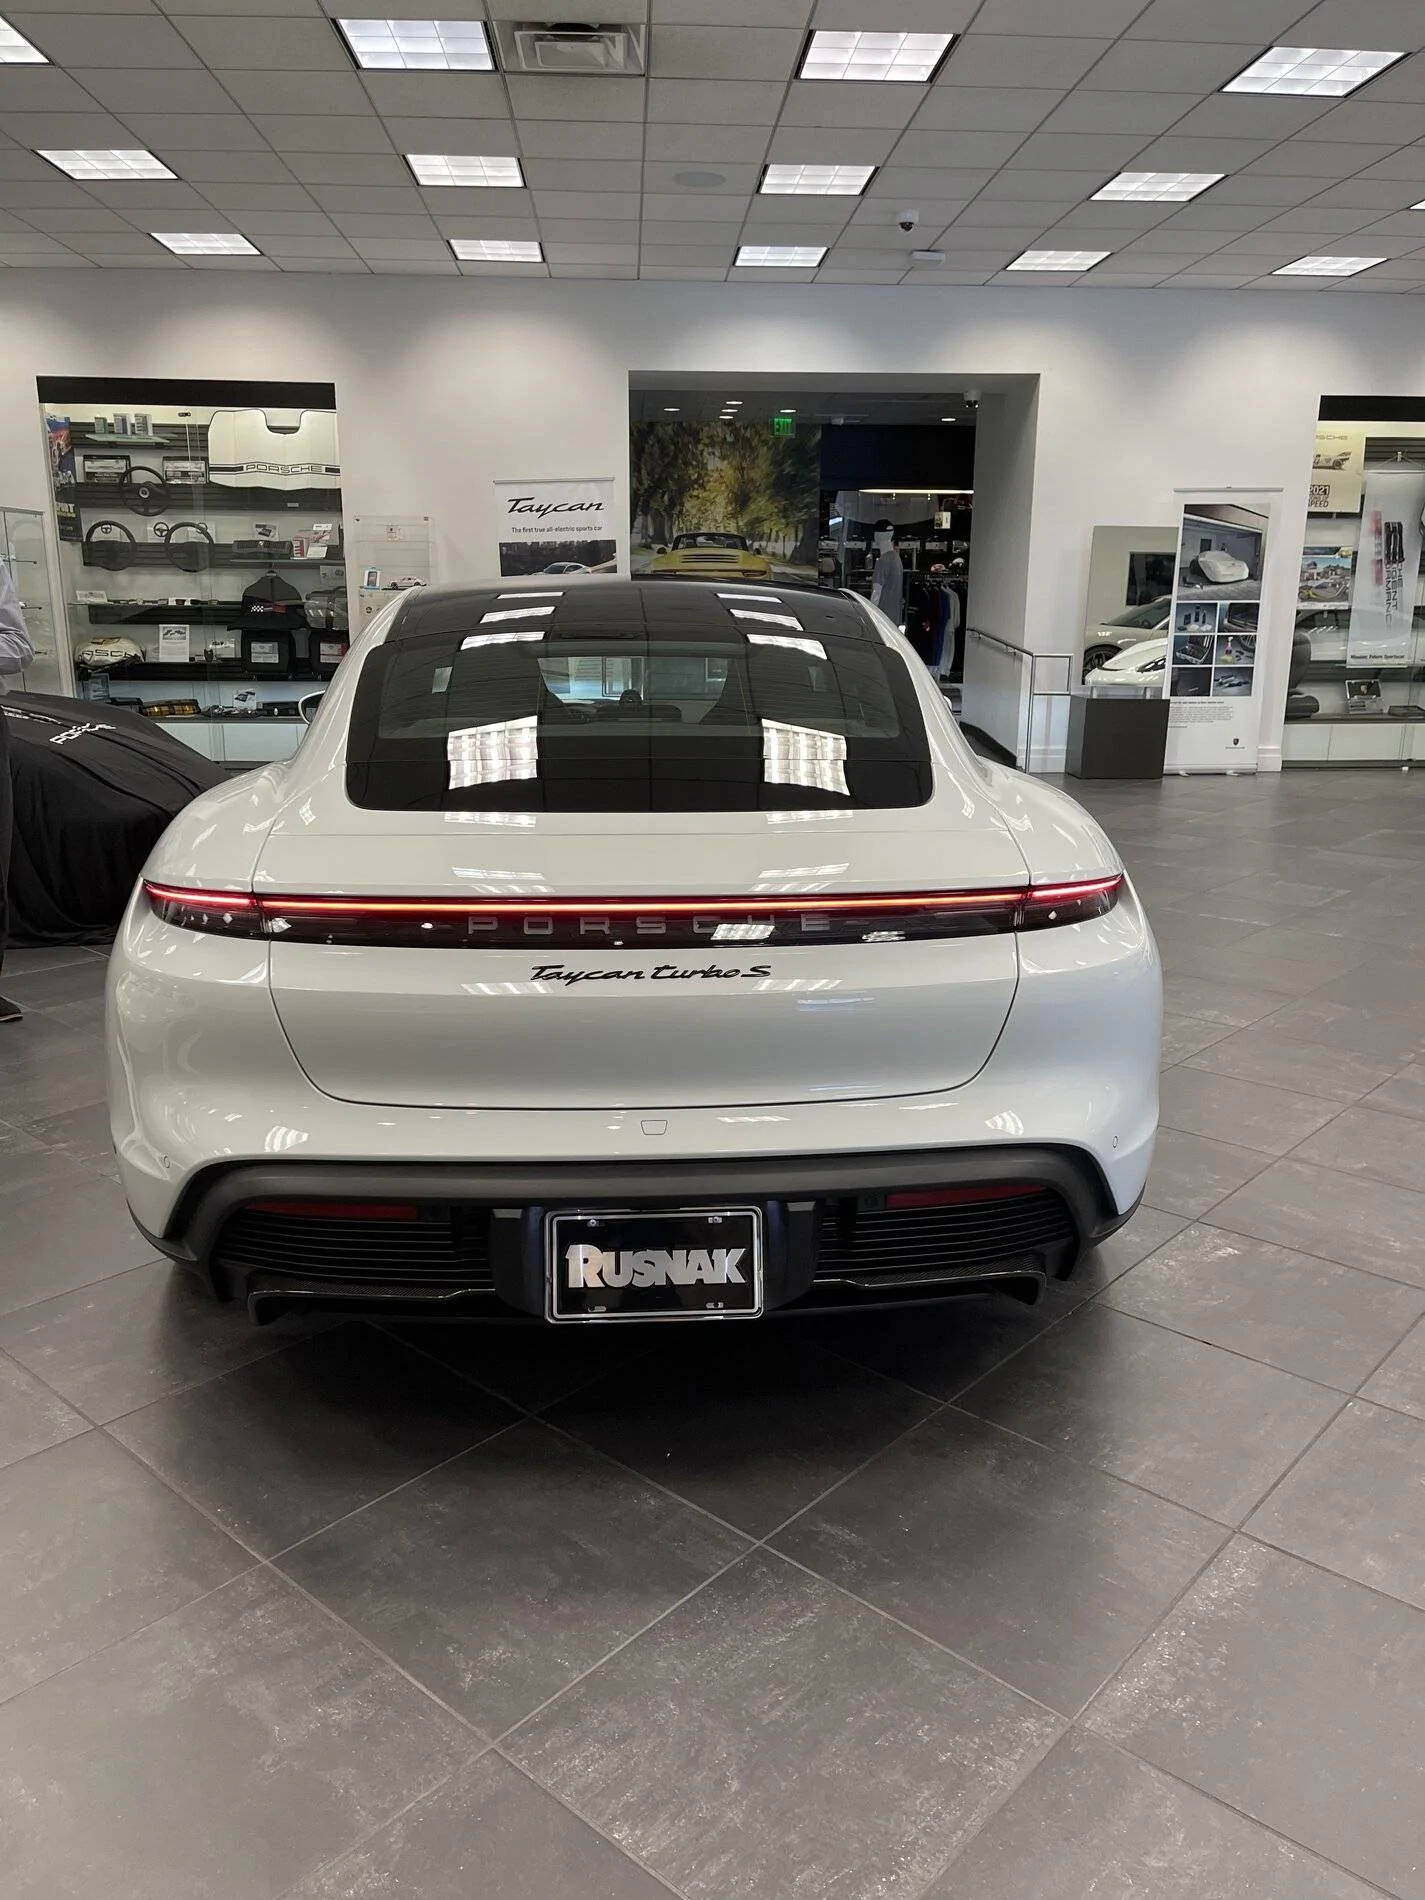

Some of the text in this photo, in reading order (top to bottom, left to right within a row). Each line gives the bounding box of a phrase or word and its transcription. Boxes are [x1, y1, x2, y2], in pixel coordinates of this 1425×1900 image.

[774, 418, 793, 435] EXIT
[245, 463, 323, 474] PORSCHE
[507, 496, 605, 519] Taycan
[546, 525, 576, 533] all-electric
[576, 525, 593, 533] sports
[530, 964, 772, 987] Taycan turbo S
[565, 1243, 746, 1288] RUSNAK
